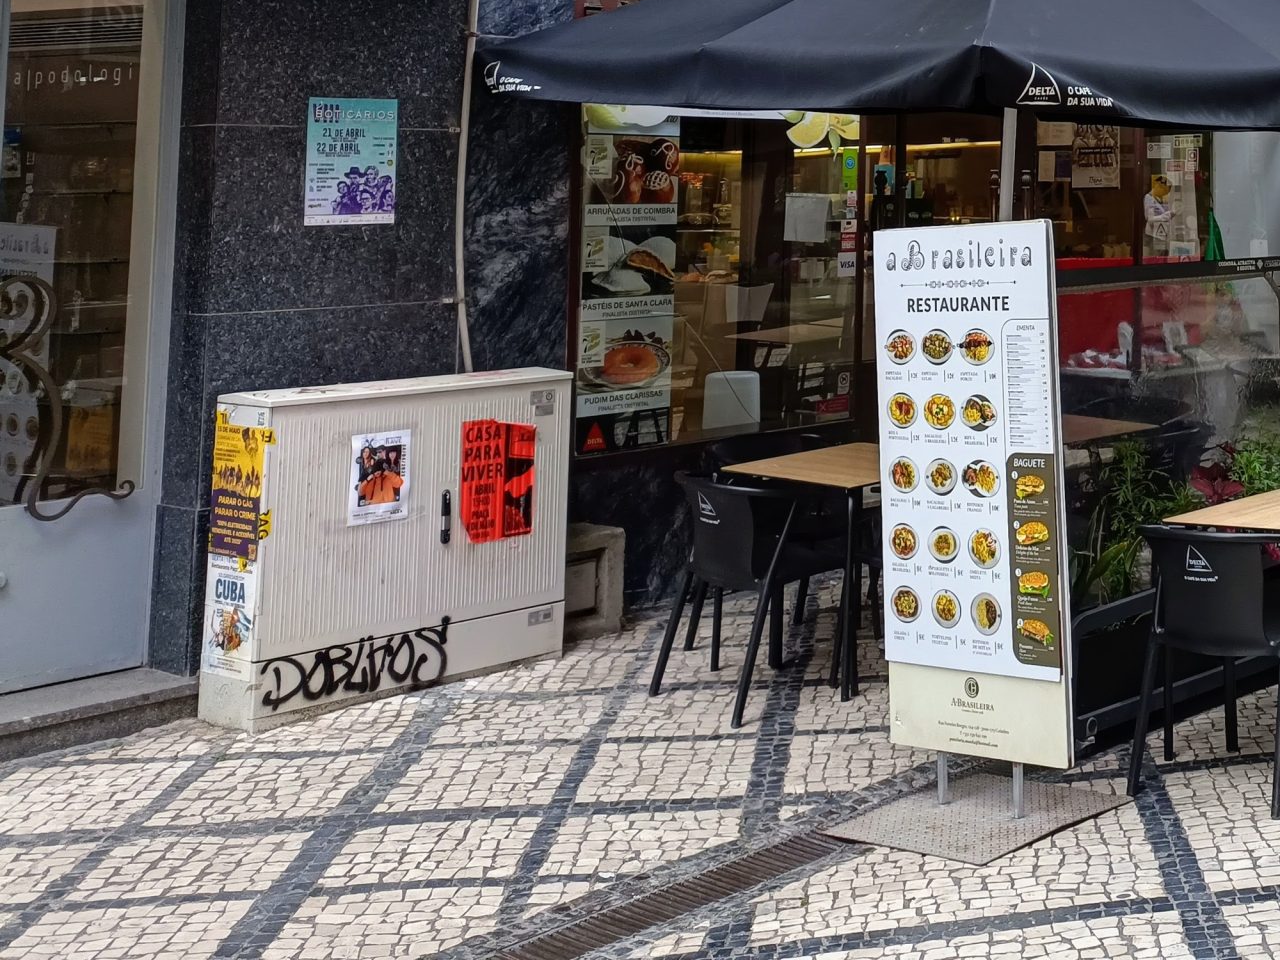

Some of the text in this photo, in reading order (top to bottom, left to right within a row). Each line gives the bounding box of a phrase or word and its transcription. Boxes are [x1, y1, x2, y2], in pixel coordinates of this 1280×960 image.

[1028, 85, 1056, 96] DELTA
[1067, 97, 1079, 106] DA
[1080, 97, 1095, 106] SUA
[345, 128, 366, 138] ABRIL
[329, 144, 338, 152] DE
[340, 143, 360, 152] ABRIL
[632, 207, 641, 215] DE
[643, 207, 676, 215] COIMBRA
[840, 261, 855, 269] VISA
[613, 301, 623, 309] DE
[625, 300, 648, 308] SANTA
[649, 298, 672, 306] CLARA
[907, 295, 1010, 313] RESTAURANTE
[609, 394, 624, 403] DAS
[465, 425, 502, 443] CASA
[465, 444, 502, 462] PARA
[1013, 458, 1046, 468] BAGUETE
[461, 462, 504, 483] VIVER
[218, 495, 237, 506] PARAR
[214, 507, 233, 516] PARAR
[215, 578, 246, 604] CUBA
